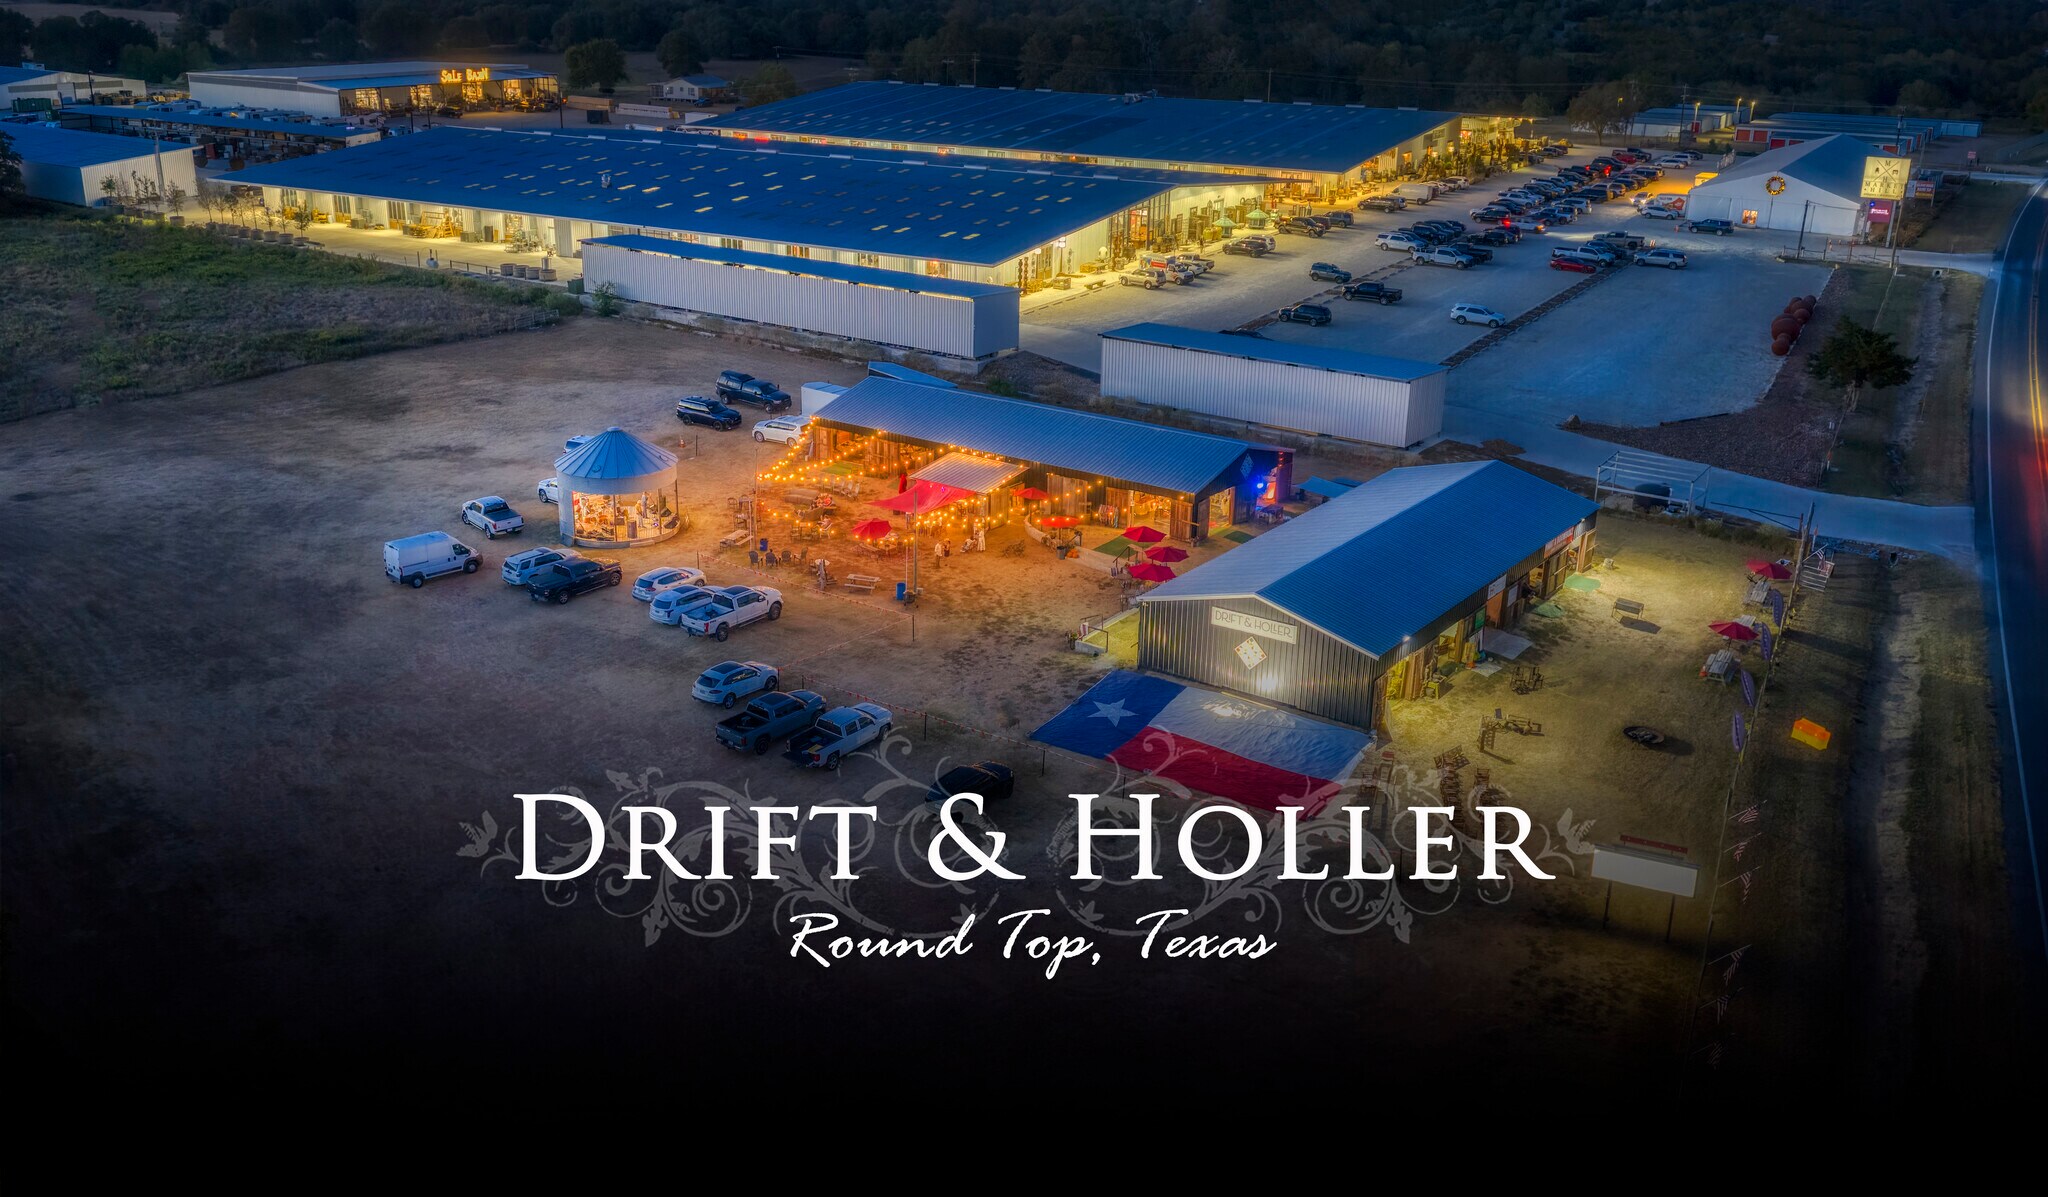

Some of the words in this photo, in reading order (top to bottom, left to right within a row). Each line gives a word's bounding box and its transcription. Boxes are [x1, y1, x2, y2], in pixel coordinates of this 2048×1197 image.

[1865, 181, 1904, 189] MARKET
[1215, 610, 1243, 625] DRIFT
[1244, 617, 1252, 628] &
[1254, 619, 1293, 638] HOLLER
